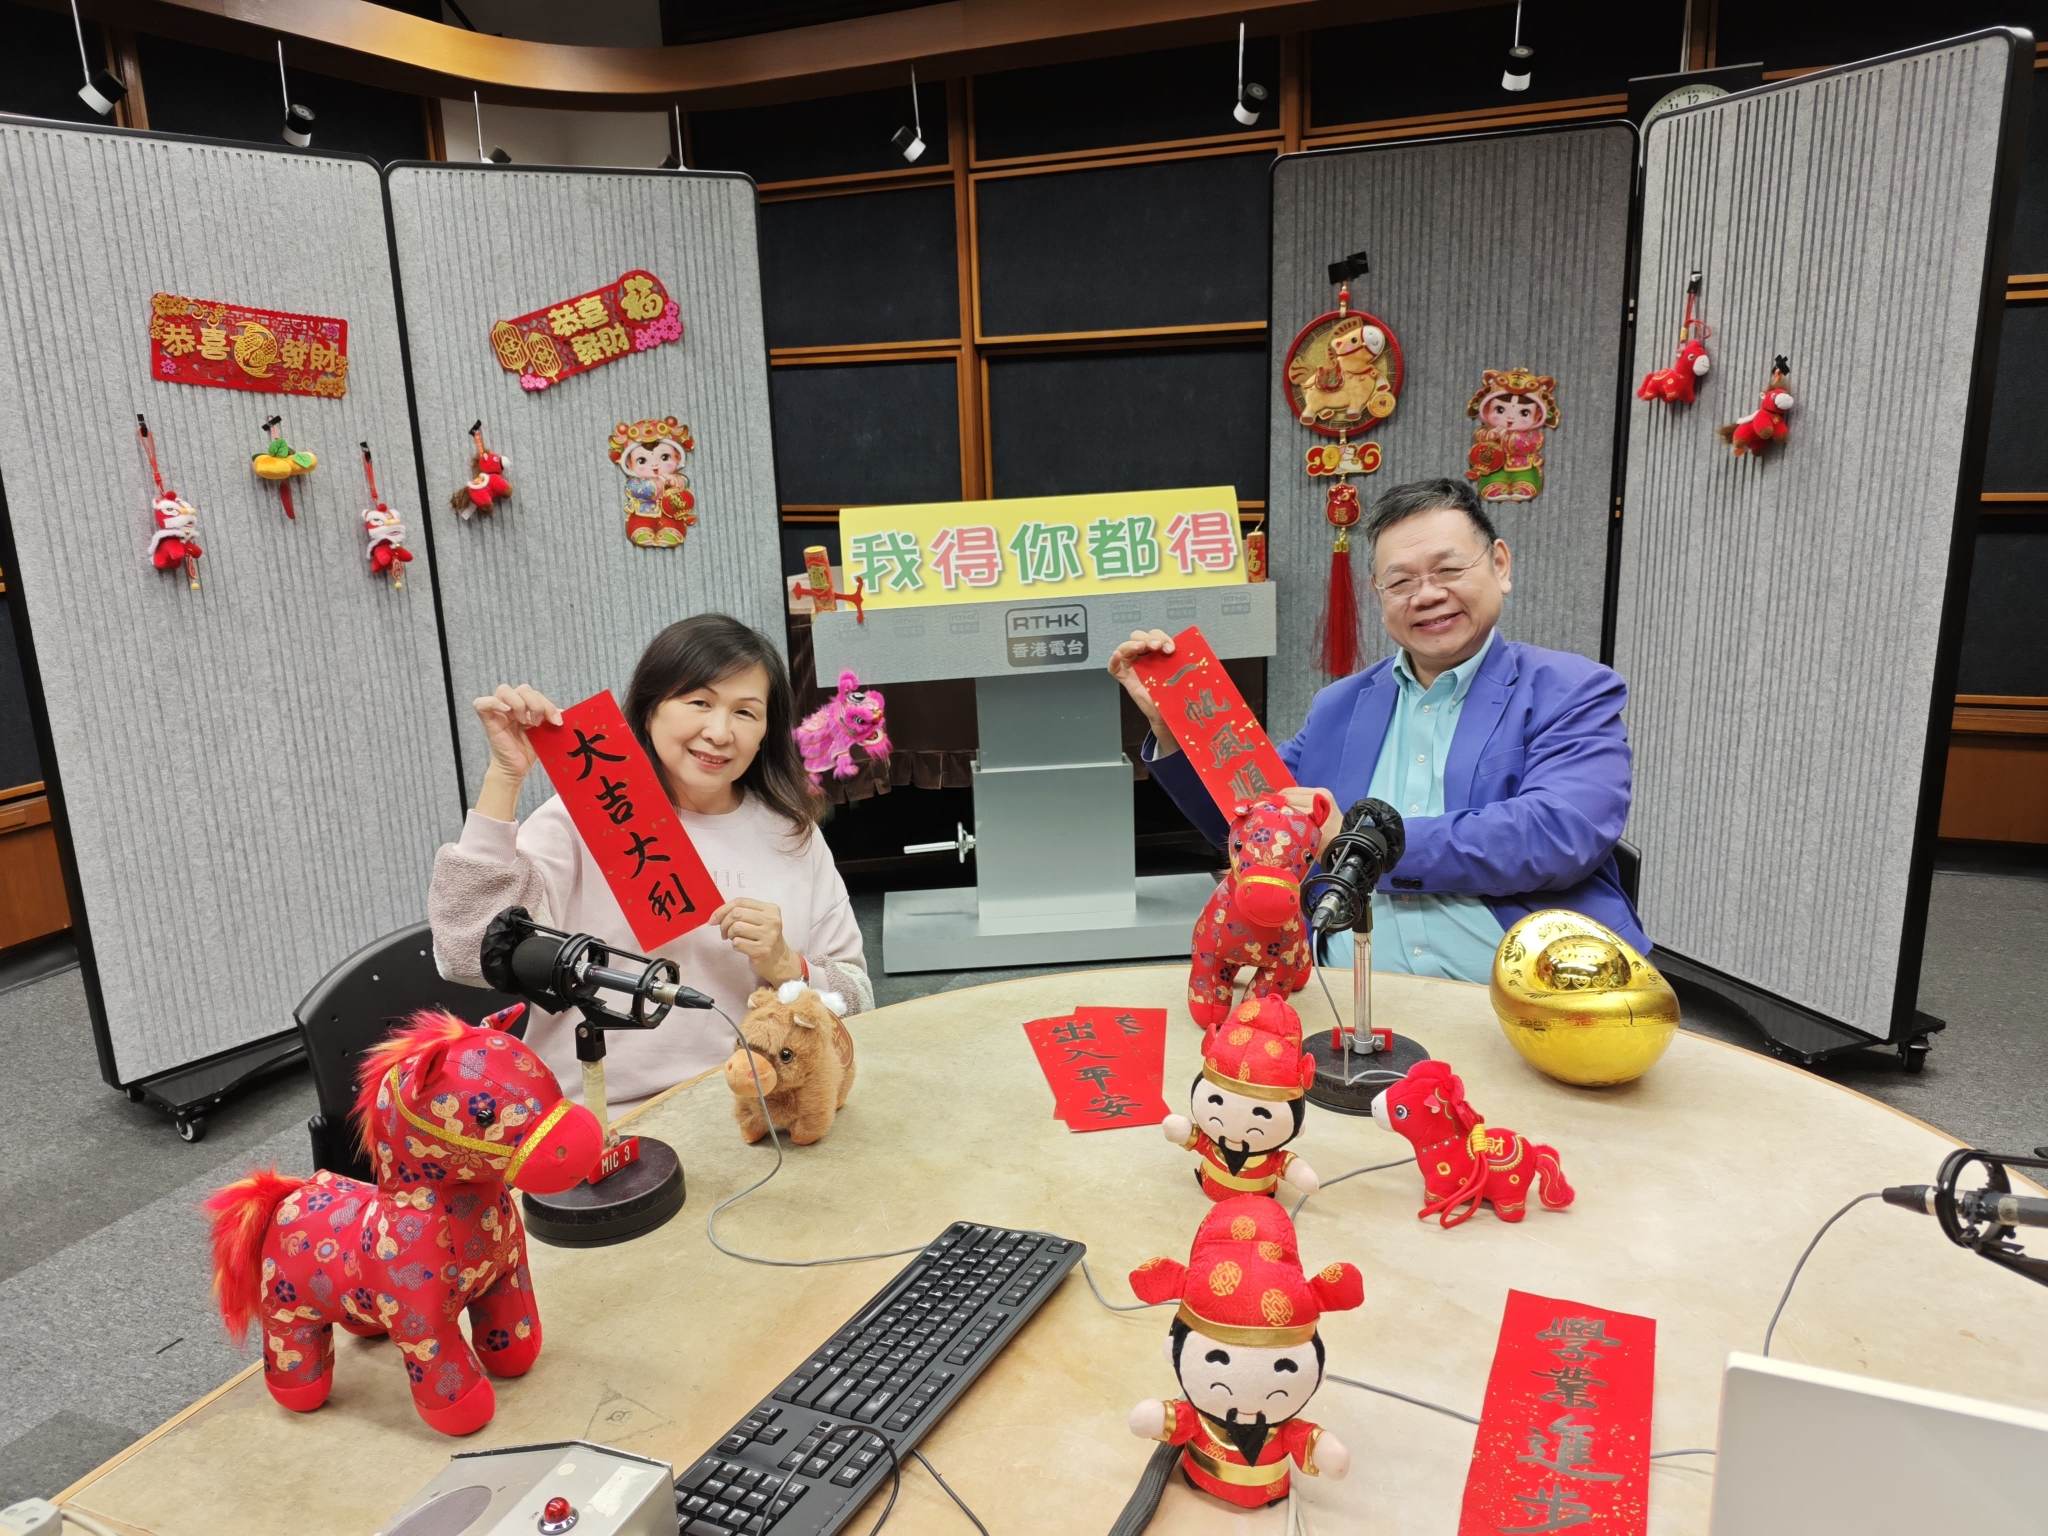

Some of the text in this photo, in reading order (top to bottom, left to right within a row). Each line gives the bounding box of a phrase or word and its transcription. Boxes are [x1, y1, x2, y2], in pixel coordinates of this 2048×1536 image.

[547, 295, 610, 338] 恭喜
[620, 275, 664, 321] 福
[570, 322, 631, 366] 發財
[850, 510, 1236, 594] 我得你都得
[1012, 612, 1081, 632] RTHK
[1012, 639, 1084, 659] 香港電台
[1165, 663, 1277, 803] 一帆風順
[566, 728, 697, 923] 大吉大利
[1051, 1021, 1144, 1120] 出入平安
[600, 1144, 631, 1176] MIC 3
[1499, 1315, 1626, 1535] 學業進步
